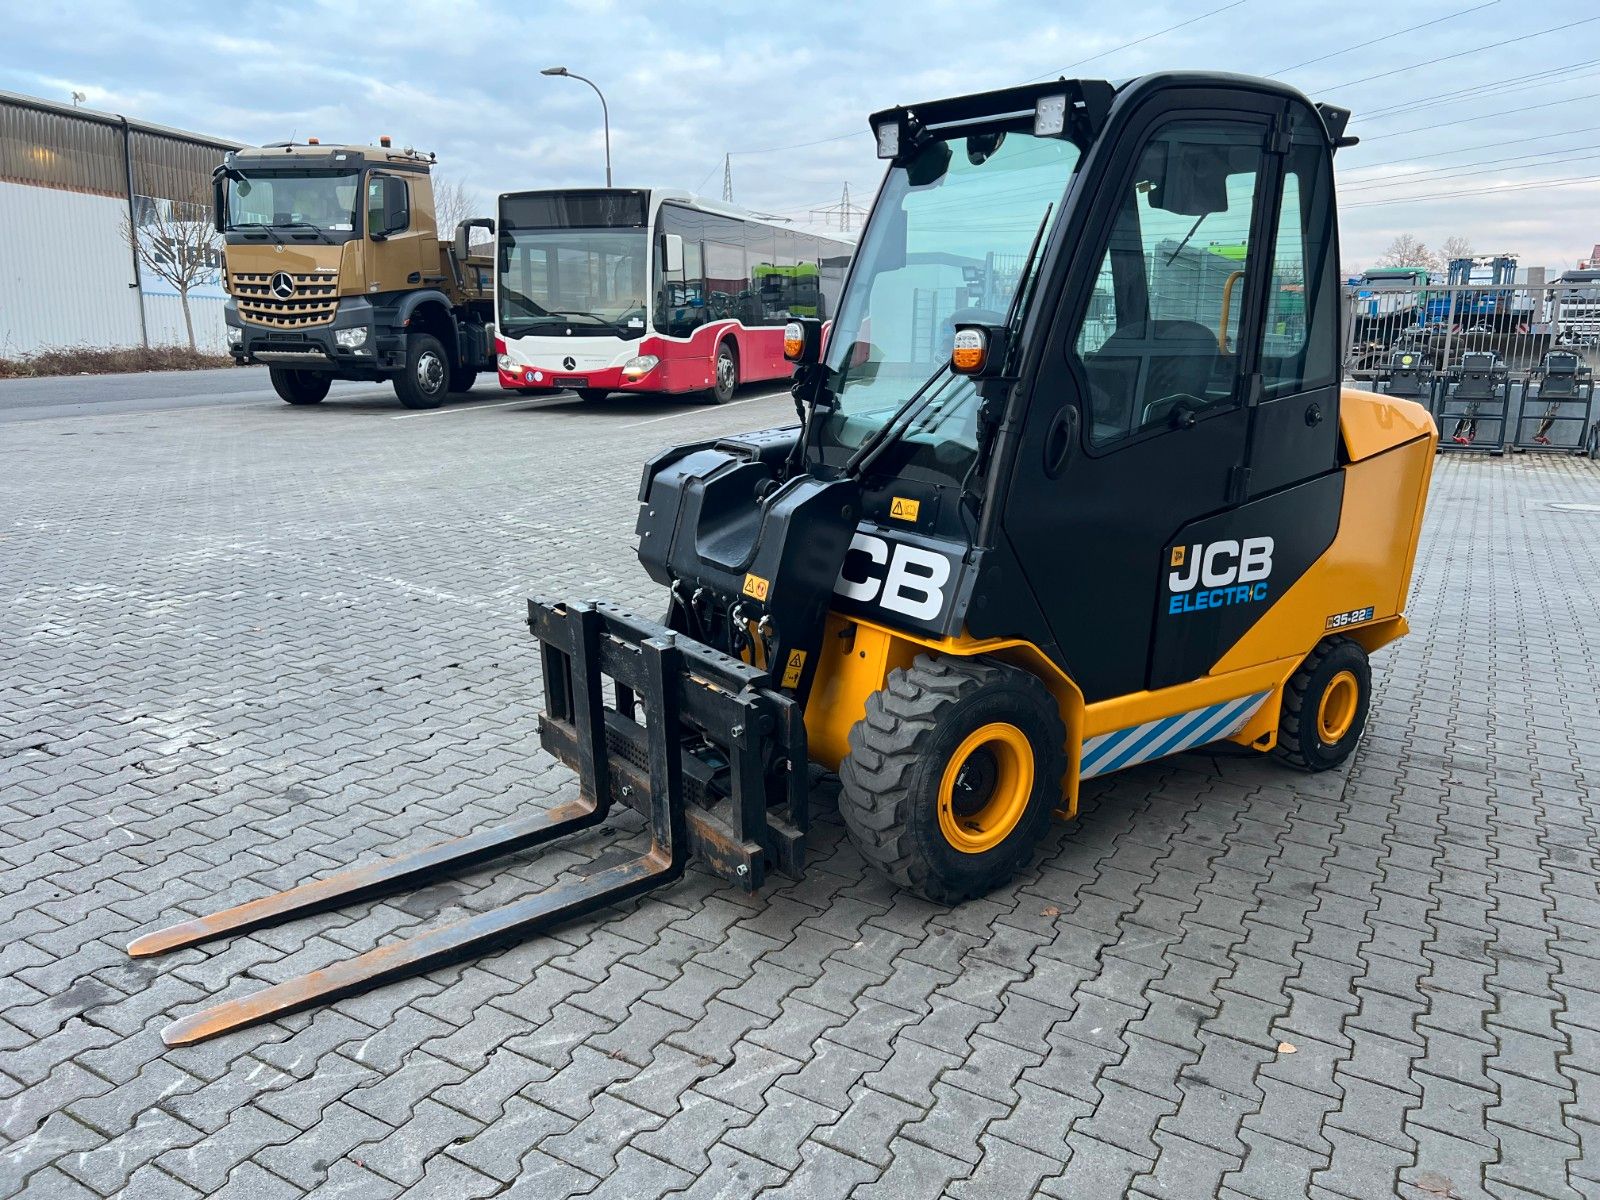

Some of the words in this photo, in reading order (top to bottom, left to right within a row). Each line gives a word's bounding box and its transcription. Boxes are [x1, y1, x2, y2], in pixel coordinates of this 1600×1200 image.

[833, 532, 951, 621] CB
[1168, 536, 1275, 593] JCB
[1168, 582, 1268, 615] ELECTRIC
